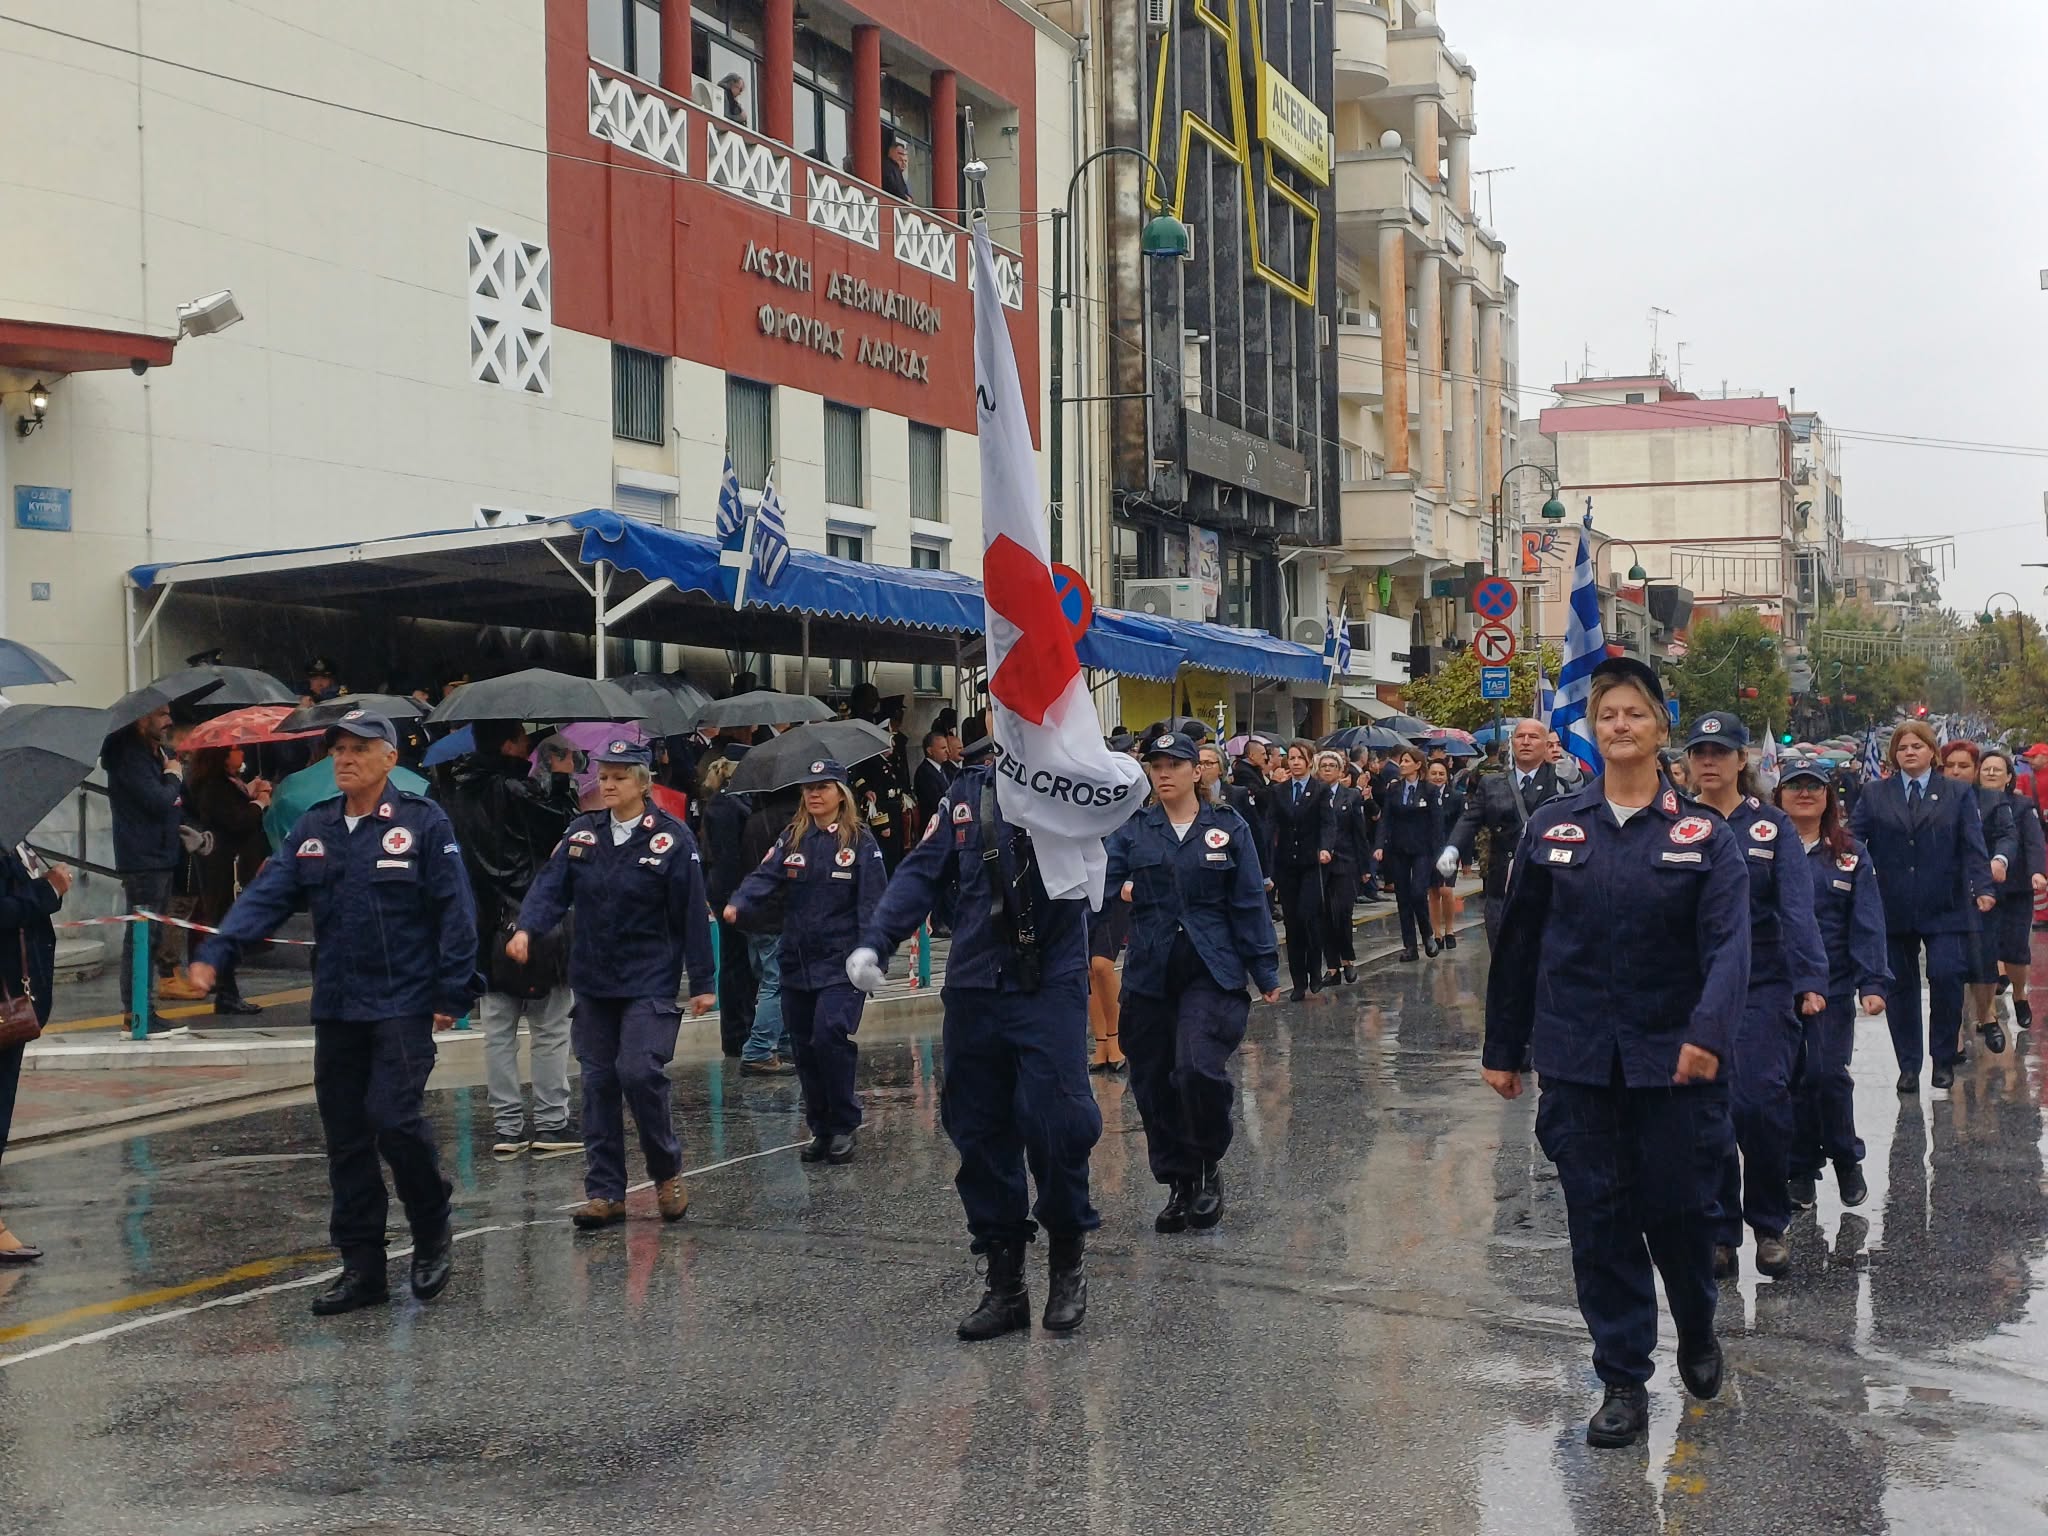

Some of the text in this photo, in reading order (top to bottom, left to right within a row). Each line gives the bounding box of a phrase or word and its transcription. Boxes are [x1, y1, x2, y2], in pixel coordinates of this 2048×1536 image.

[1272, 81, 1324, 153] ALTERLIFE
[740, 239, 941, 336] ΛΕΣΧΗ ΑΞΙΩΜΑΤΙΚΩΝ
[758, 303, 929, 384] ΦΡΟΥΡΑΣ ΛΑΡΙΣΑΣ
[28, 501, 62, 513] ΚΥΠΡΟΥ
[1031, 770, 1129, 807] CROSS
